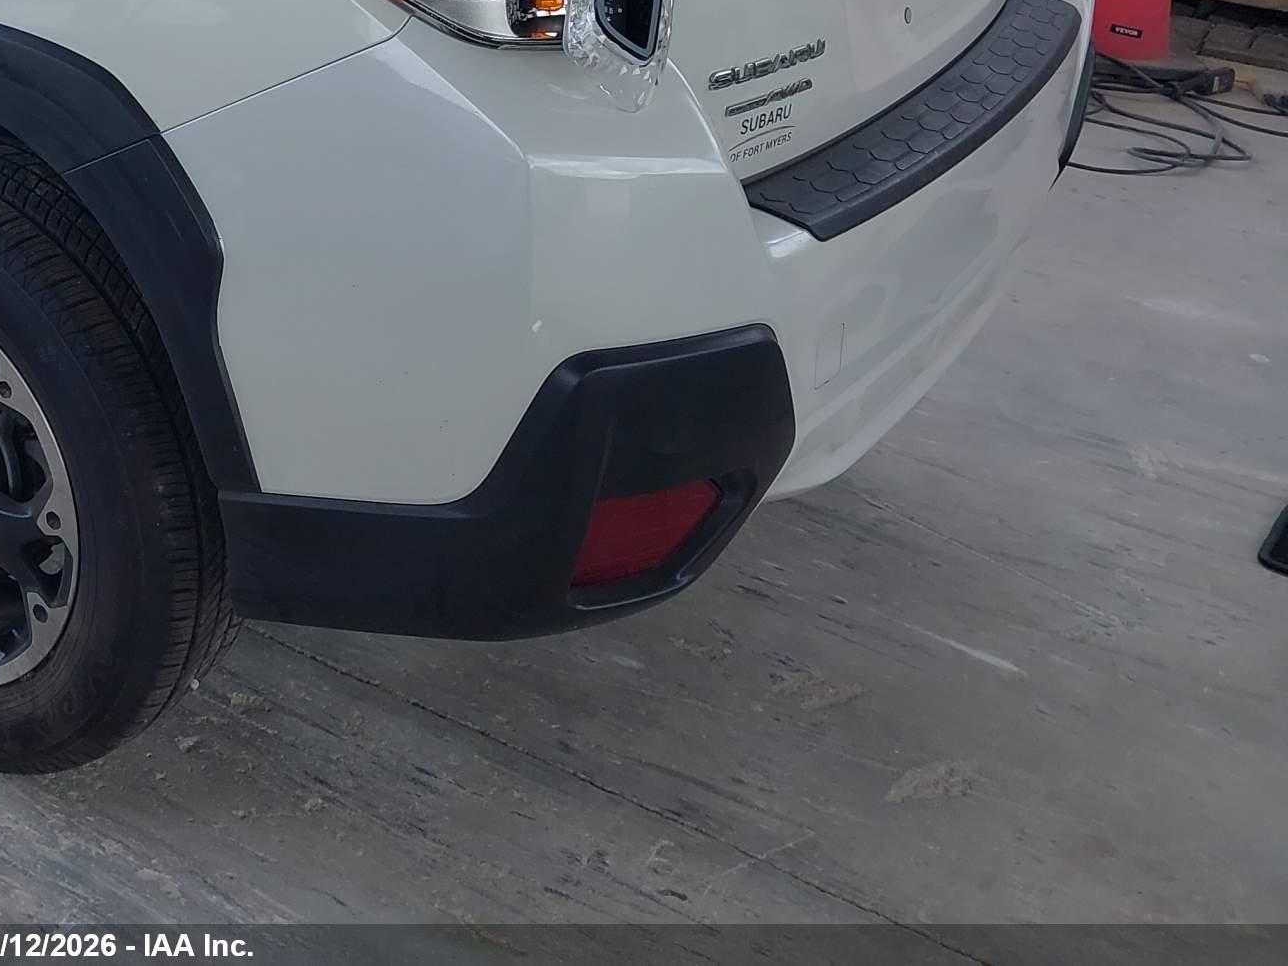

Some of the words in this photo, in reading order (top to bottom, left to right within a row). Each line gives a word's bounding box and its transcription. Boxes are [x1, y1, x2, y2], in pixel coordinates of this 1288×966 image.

[708, 38, 826, 90] SUBARU
[740, 103, 793, 135] SUBARU
[729, 151, 742, 163] OF
[742, 143, 764, 160] FORT
[765, 131, 793, 151] MYERS
